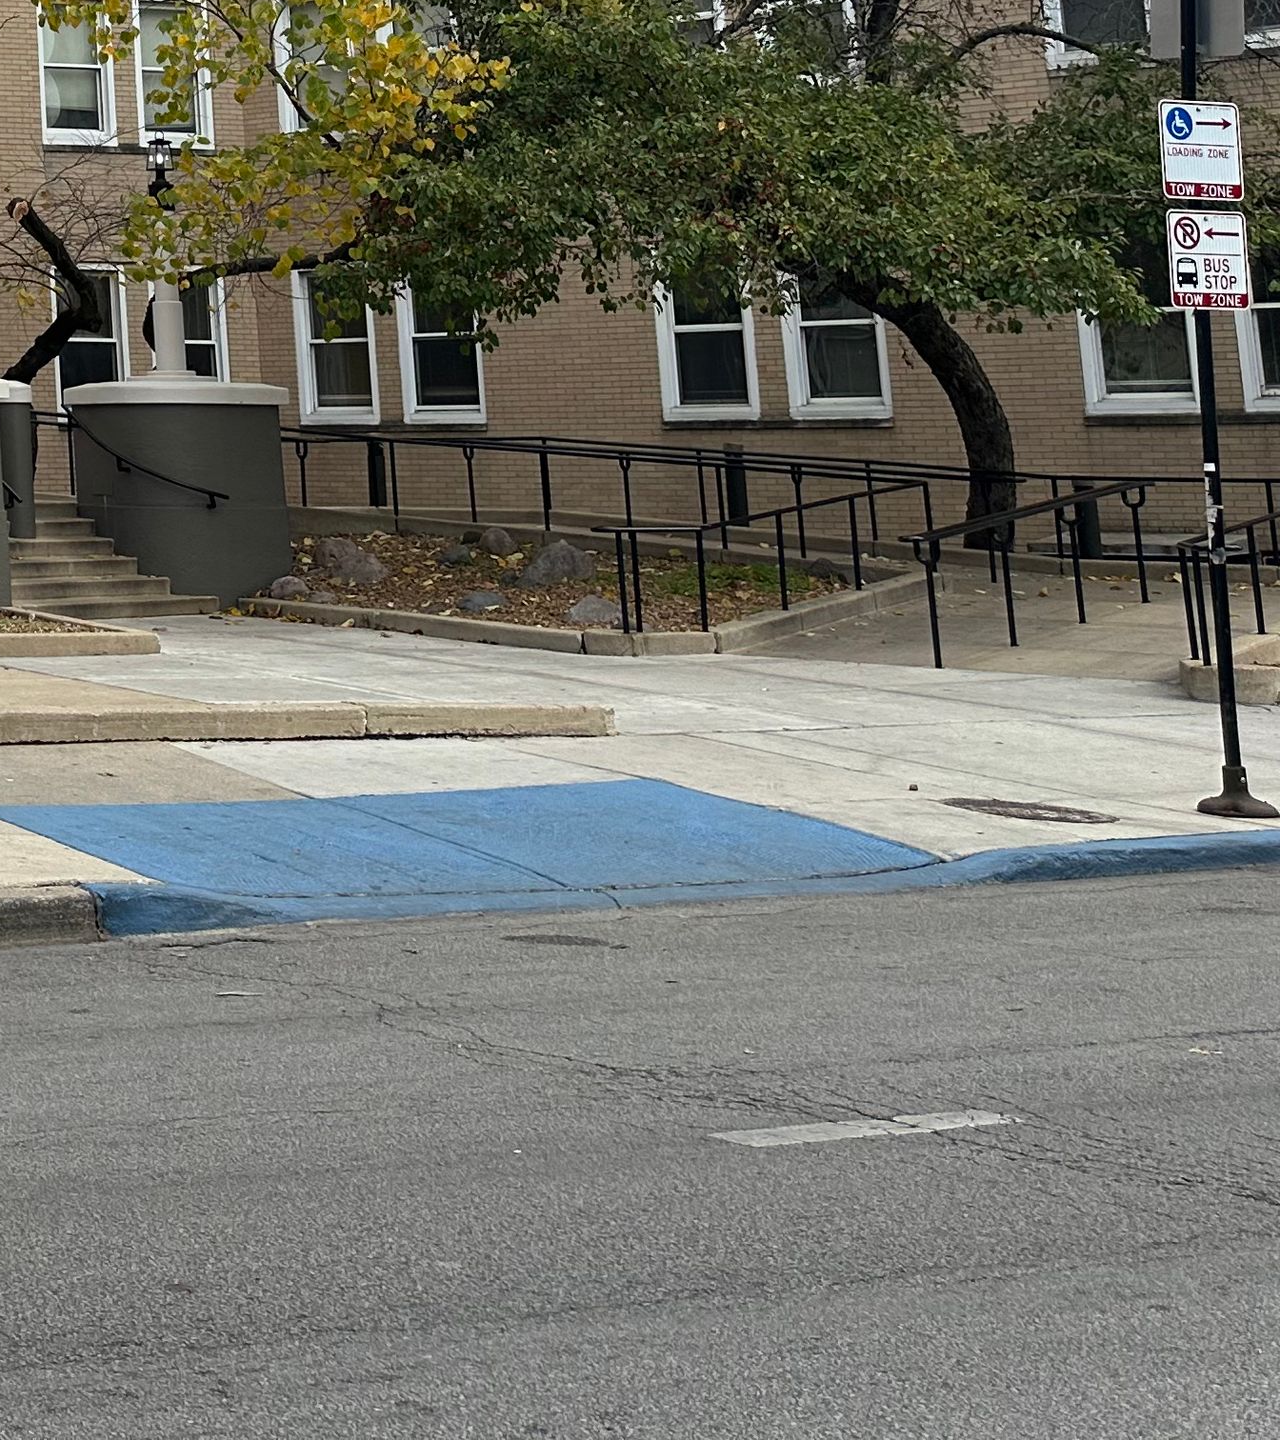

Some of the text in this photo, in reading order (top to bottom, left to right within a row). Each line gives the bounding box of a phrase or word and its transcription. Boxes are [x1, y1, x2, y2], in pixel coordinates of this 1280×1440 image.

[1167, 146, 1230, 159] LOADING ZONE
[1169, 183, 1235, 198] TOW ZONE
[1203, 257, 1230, 273] BUS
[1204, 274, 1237, 290] STOP
[1177, 293, 1243, 307] TOW ZONE
